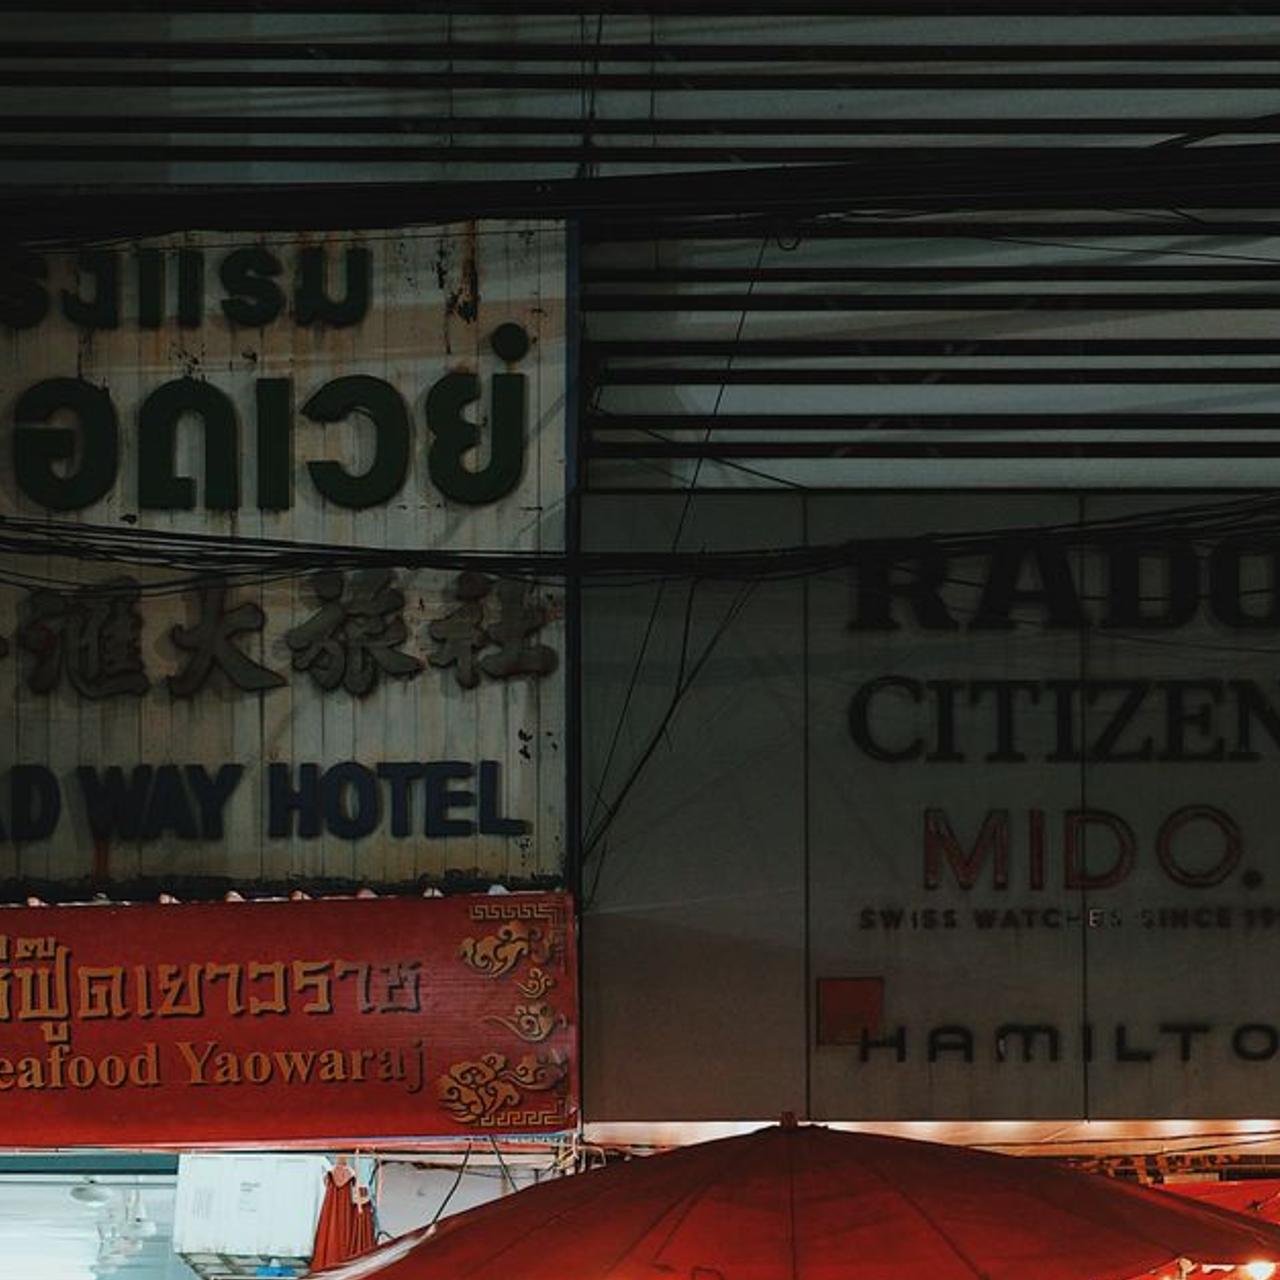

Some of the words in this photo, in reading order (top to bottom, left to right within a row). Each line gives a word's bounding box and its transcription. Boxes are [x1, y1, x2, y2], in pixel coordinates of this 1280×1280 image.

[76, 764, 245, 841] WAY
[269, 761, 535, 839] HOTEL
[860, 907, 959, 931] SWISS
[173, 1036, 428, 1094] Yaowaraj
